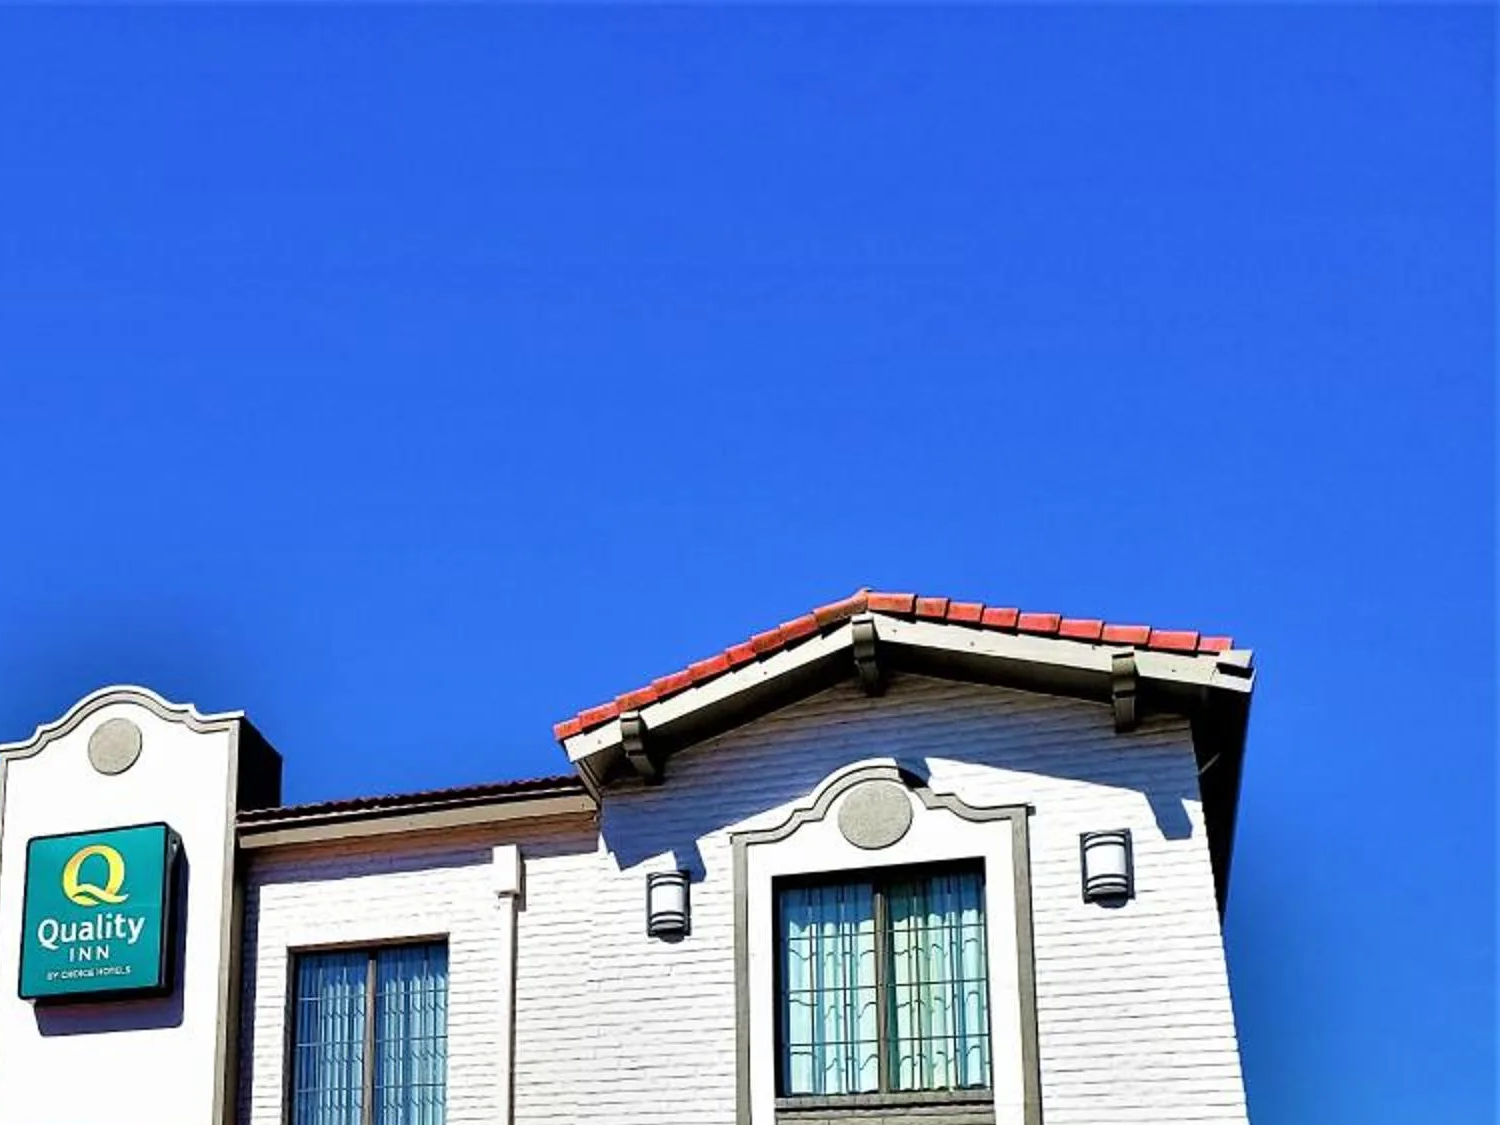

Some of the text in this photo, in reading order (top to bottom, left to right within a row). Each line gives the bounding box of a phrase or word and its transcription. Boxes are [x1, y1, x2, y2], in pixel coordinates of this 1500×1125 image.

[63, 845, 129, 906] Q
[37, 912, 145, 950] Quality
[69, 945, 109, 962] INN
